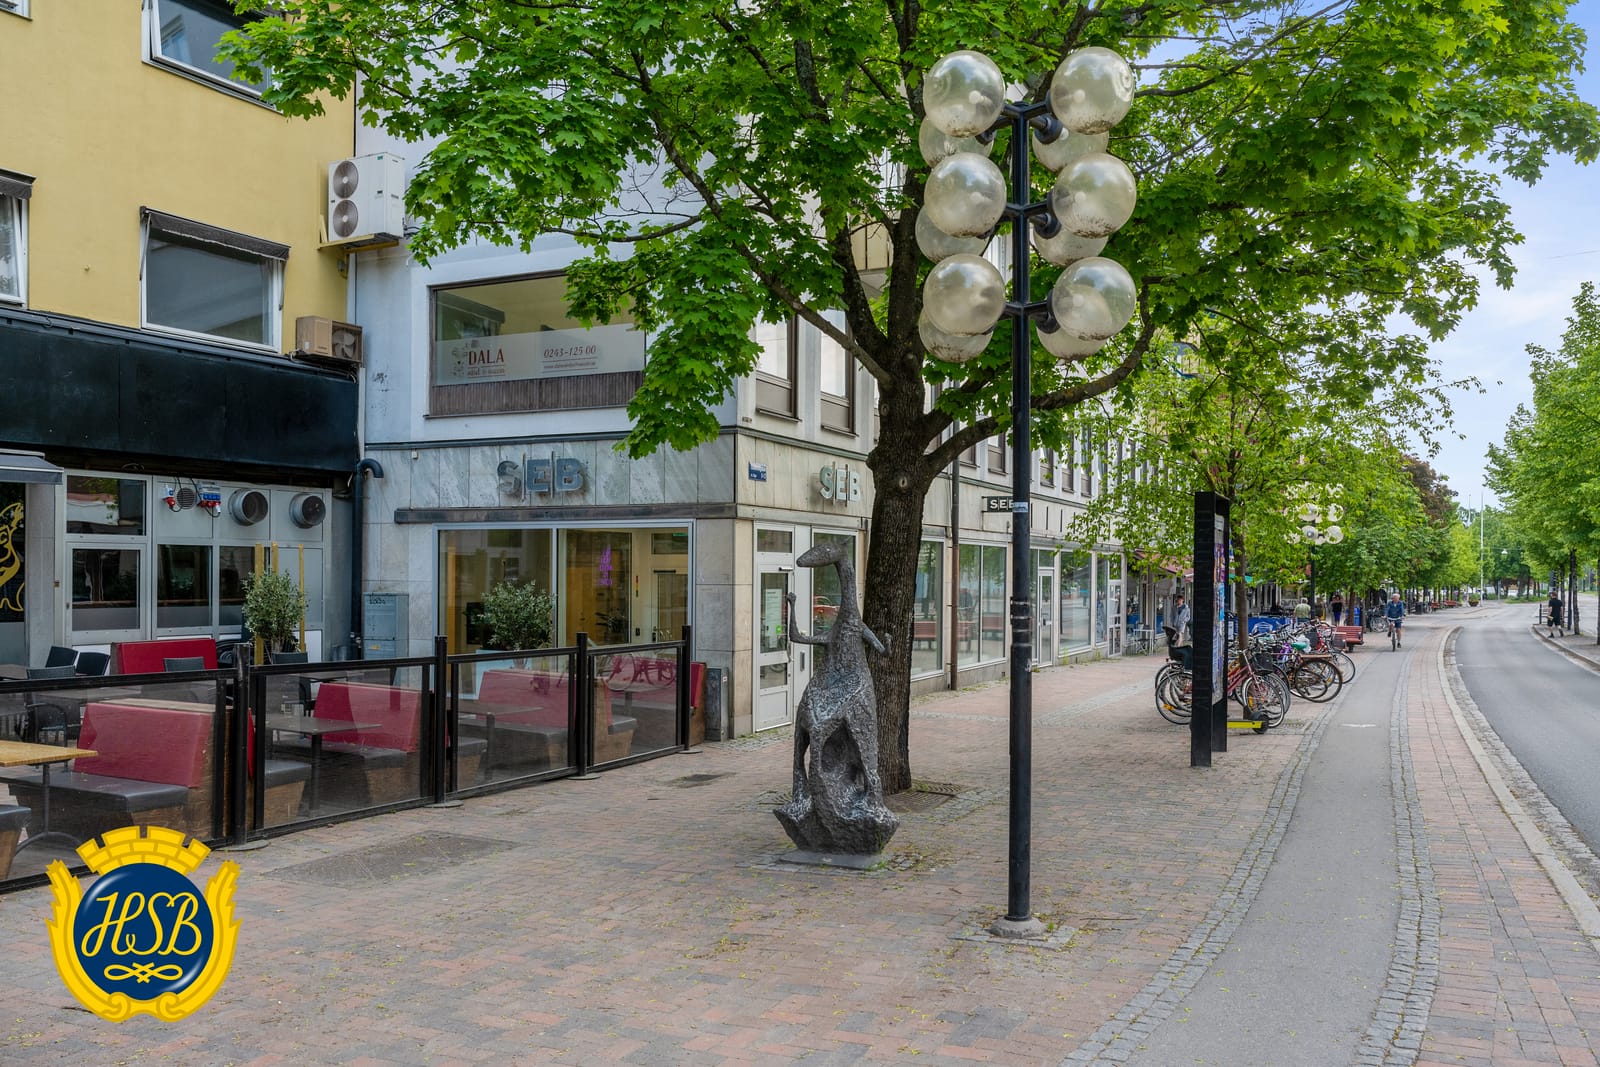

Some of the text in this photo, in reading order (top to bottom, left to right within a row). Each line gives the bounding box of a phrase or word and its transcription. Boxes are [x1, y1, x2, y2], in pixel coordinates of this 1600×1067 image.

[468, 348, 505, 366] DALA
[497, 457, 584, 495] SEB
[819, 464, 861, 502] SEB
